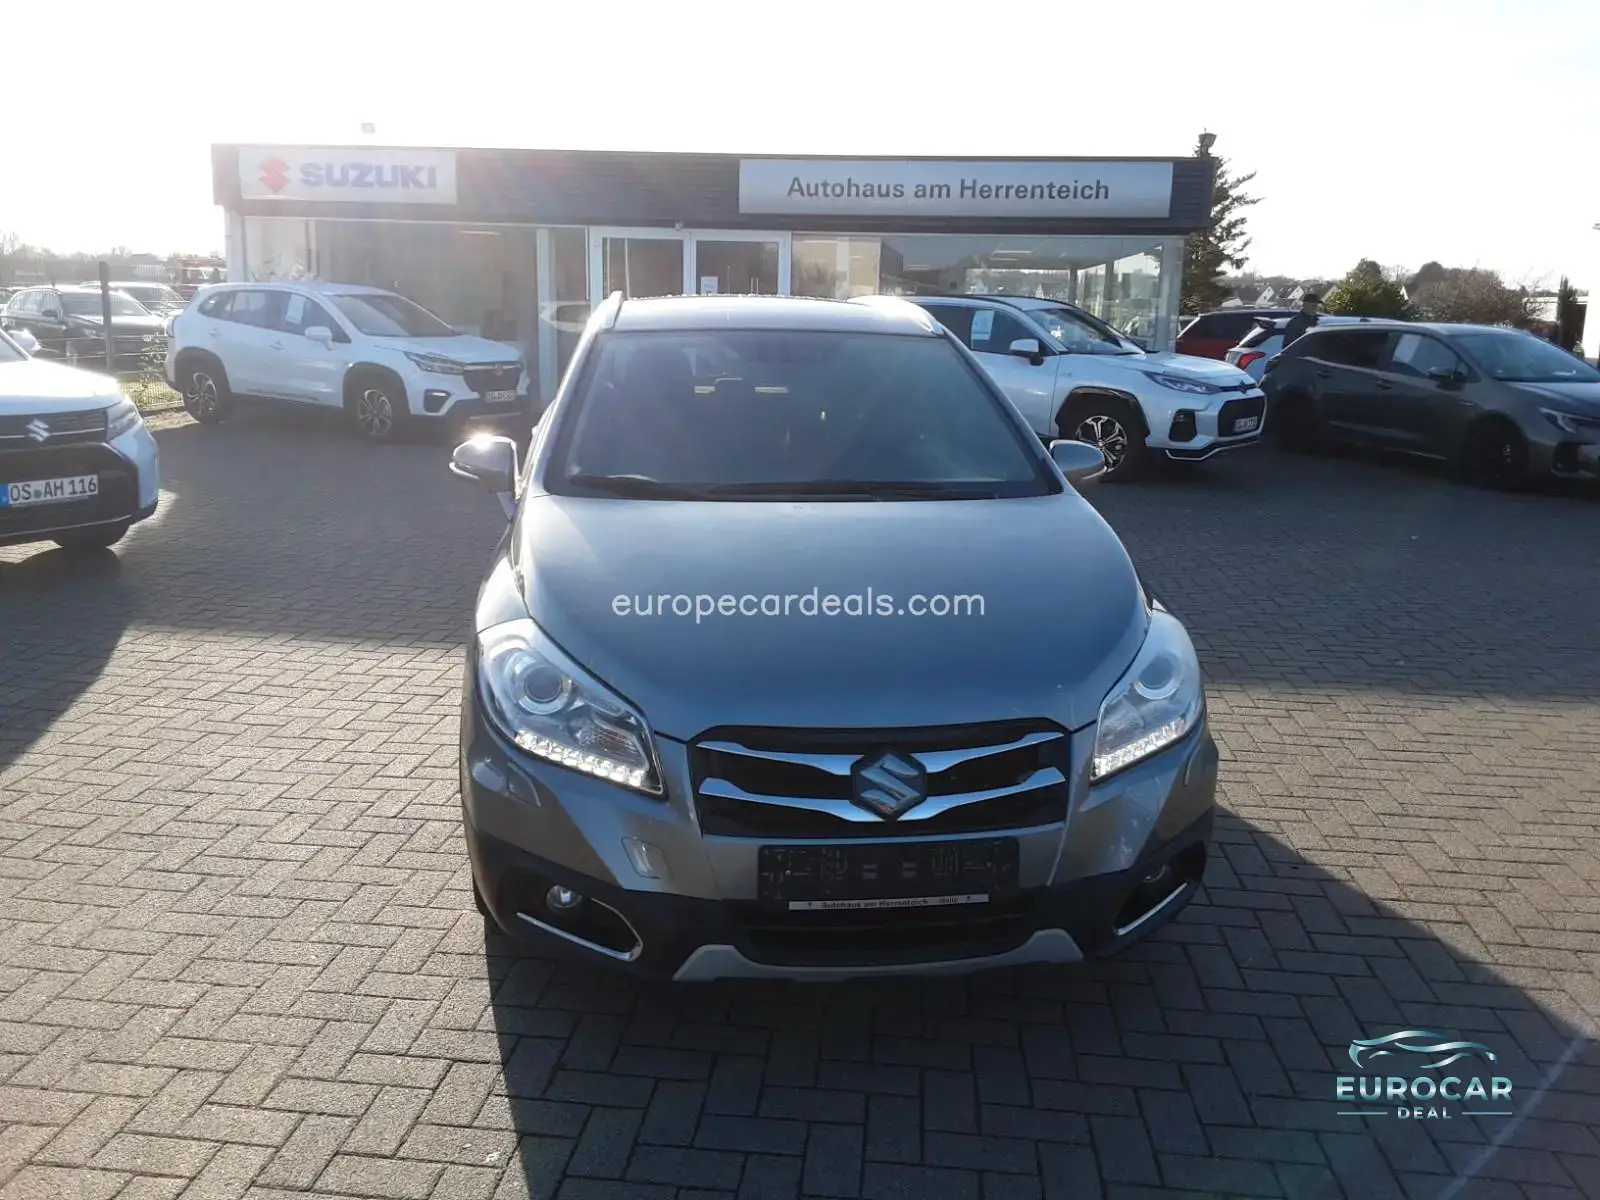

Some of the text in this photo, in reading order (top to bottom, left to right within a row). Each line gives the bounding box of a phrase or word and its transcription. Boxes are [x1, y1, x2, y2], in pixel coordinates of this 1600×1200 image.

[299, 162, 437, 189] SUZUKI
[787, 176, 1109, 199] Autohaus am Herrenteich
[10, 477, 97, 501] OS AH 116
